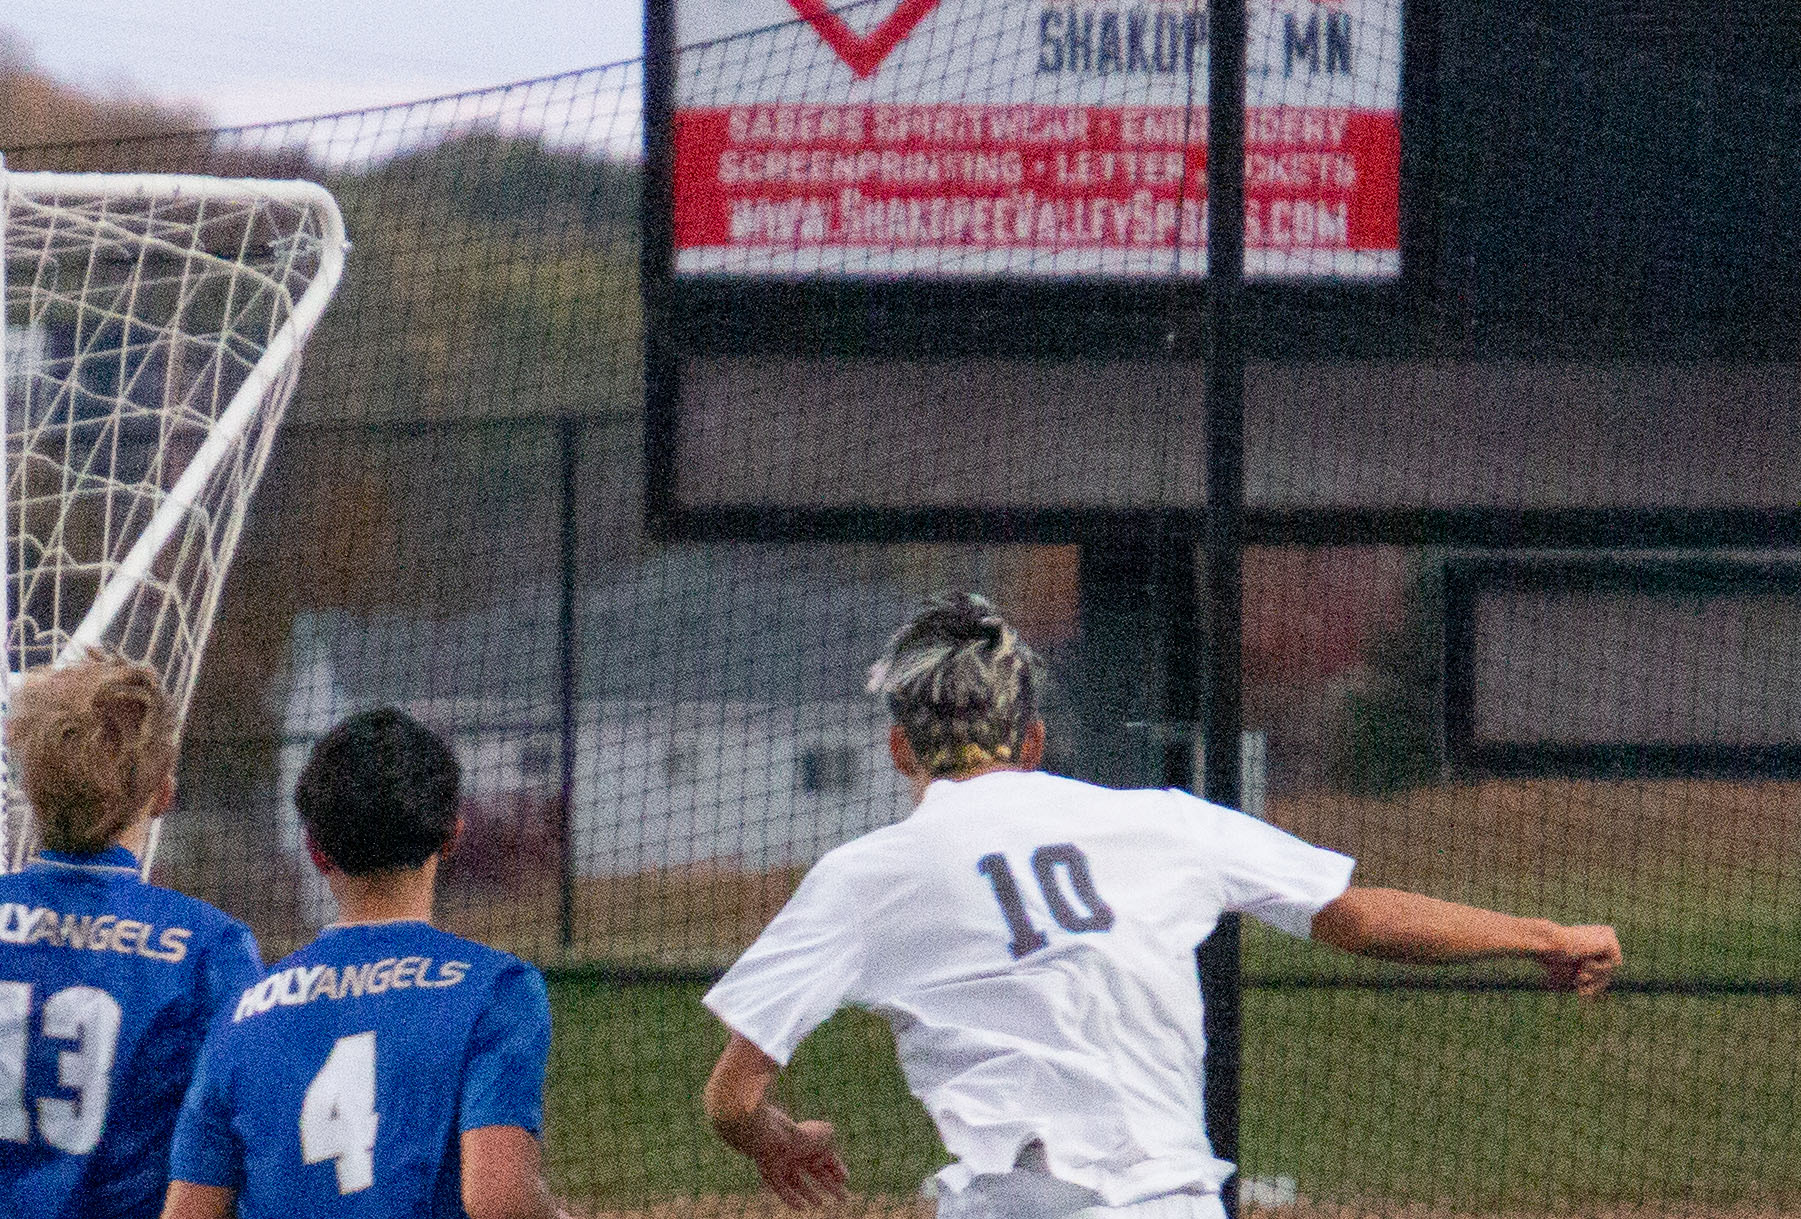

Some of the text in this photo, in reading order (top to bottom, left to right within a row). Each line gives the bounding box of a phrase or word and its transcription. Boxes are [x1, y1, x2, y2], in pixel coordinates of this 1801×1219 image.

[1283, 10, 1352, 79] MN
[718, 150, 1023, 184] SCREENPRINTING
[1057, 151, 1184, 184] LETTER
[976, 841, 1116, 961] 10
[300, 1030, 381, 1196] 4
